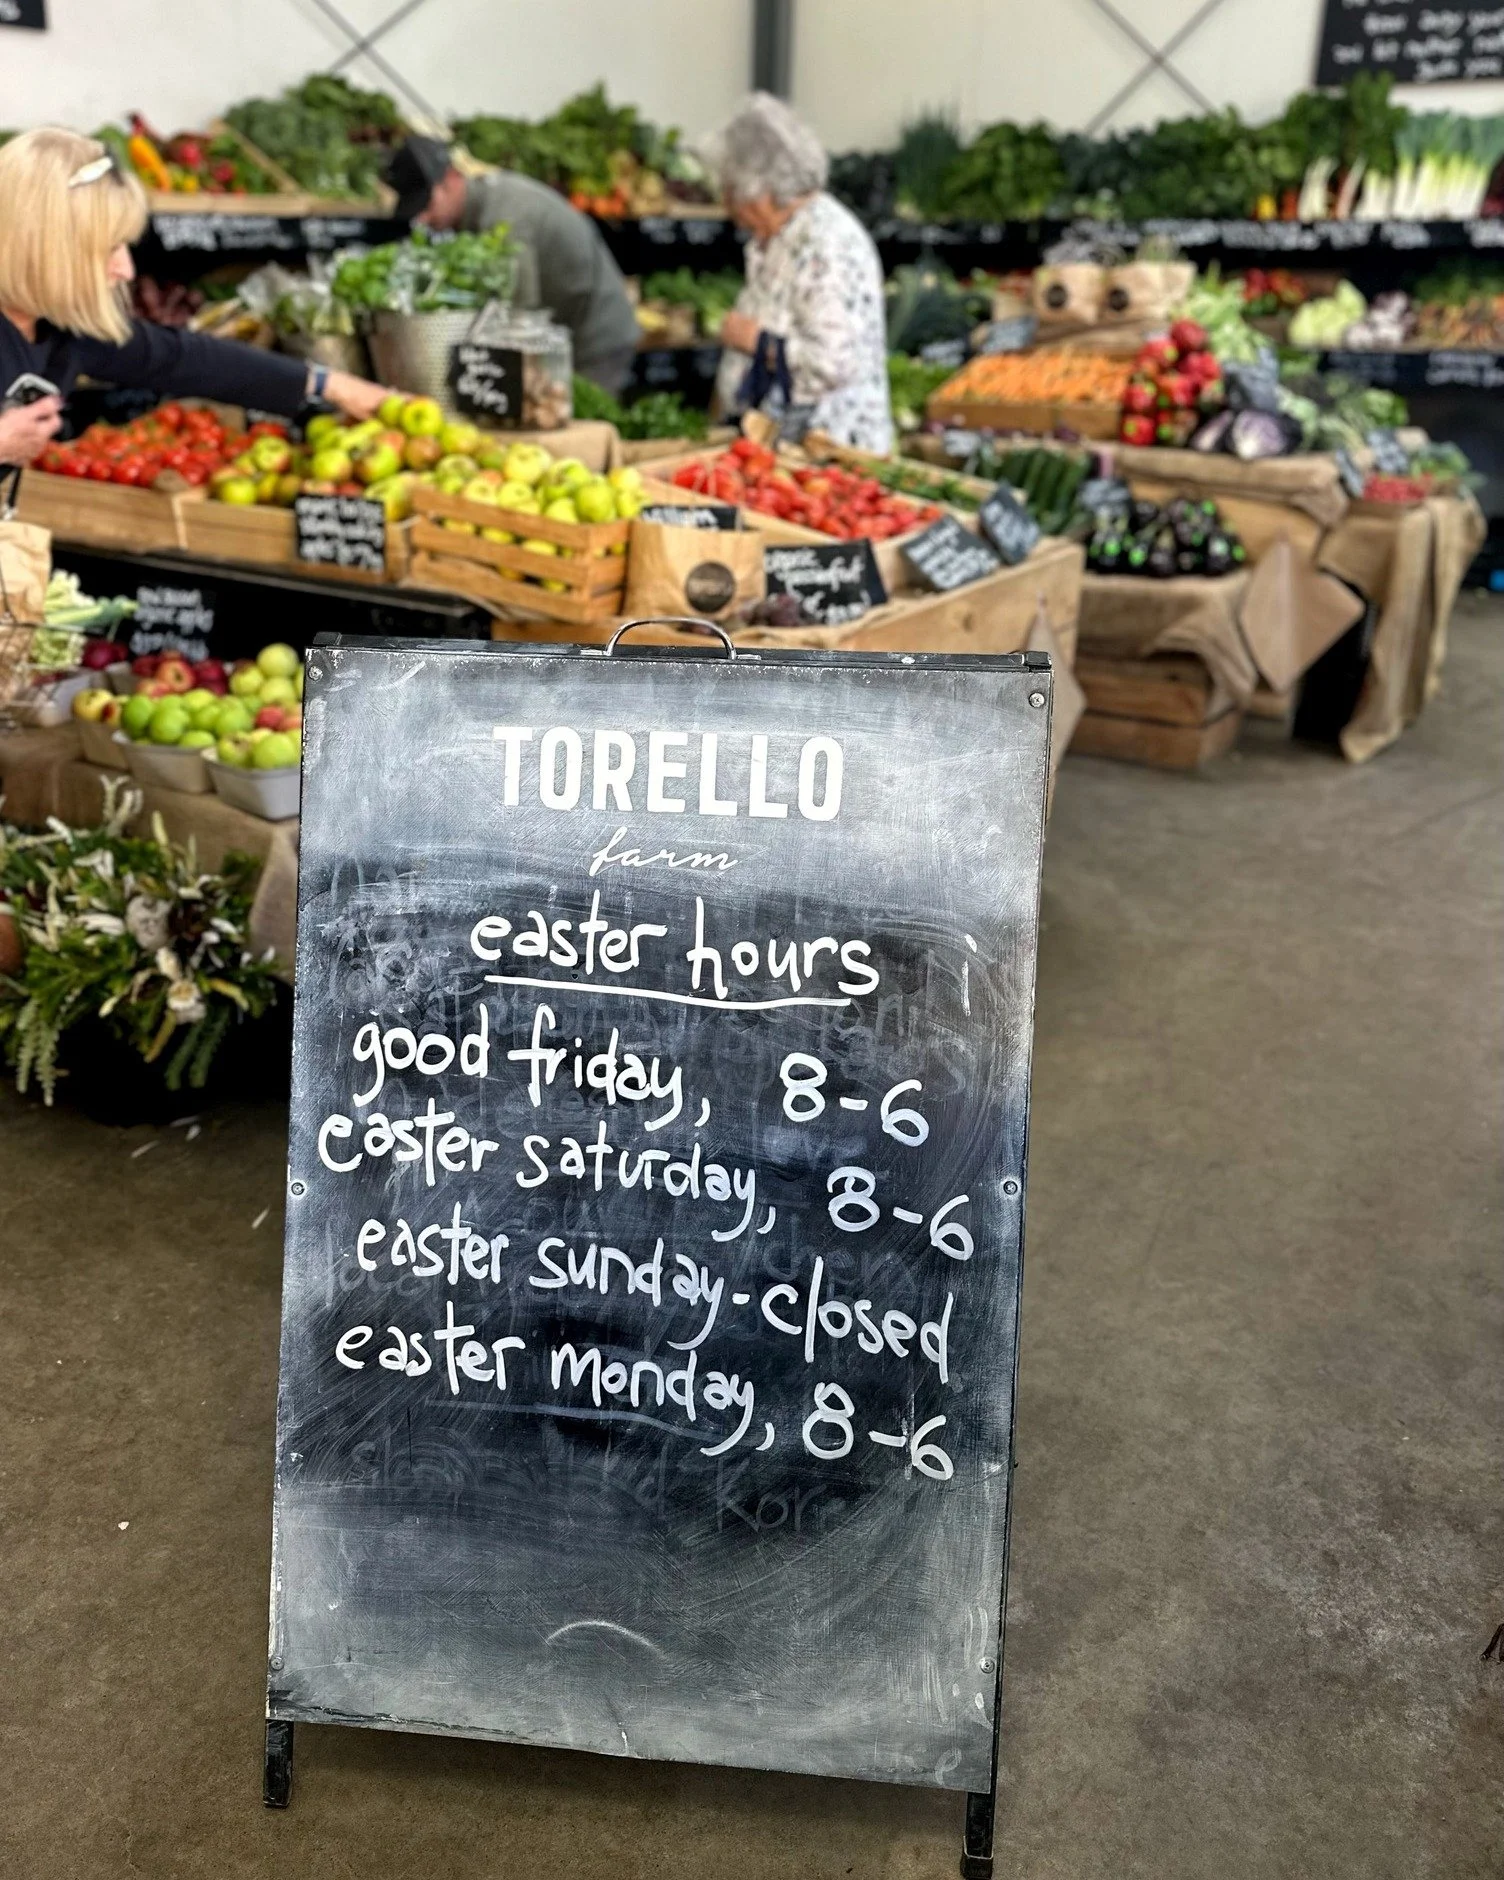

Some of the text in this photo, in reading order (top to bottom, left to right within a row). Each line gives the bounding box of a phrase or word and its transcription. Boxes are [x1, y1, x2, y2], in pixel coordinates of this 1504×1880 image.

[493, 726, 844, 822] TORELLO
[589, 826, 739, 877] farm
[469, 889, 880, 999] easter hours
[353, 1004, 491, 1109] good
[507, 1003, 712, 1131] friday,
[780, 1053, 930, 1147] 8-6
[317, 1098, 500, 1188] easter
[515, 1121, 776, 1242] saturday,
[826, 1166, 974, 1261] 8-6
[356, 1201, 508, 1286] easter
[335, 1300, 954, 1482] easter monday, 8-6
